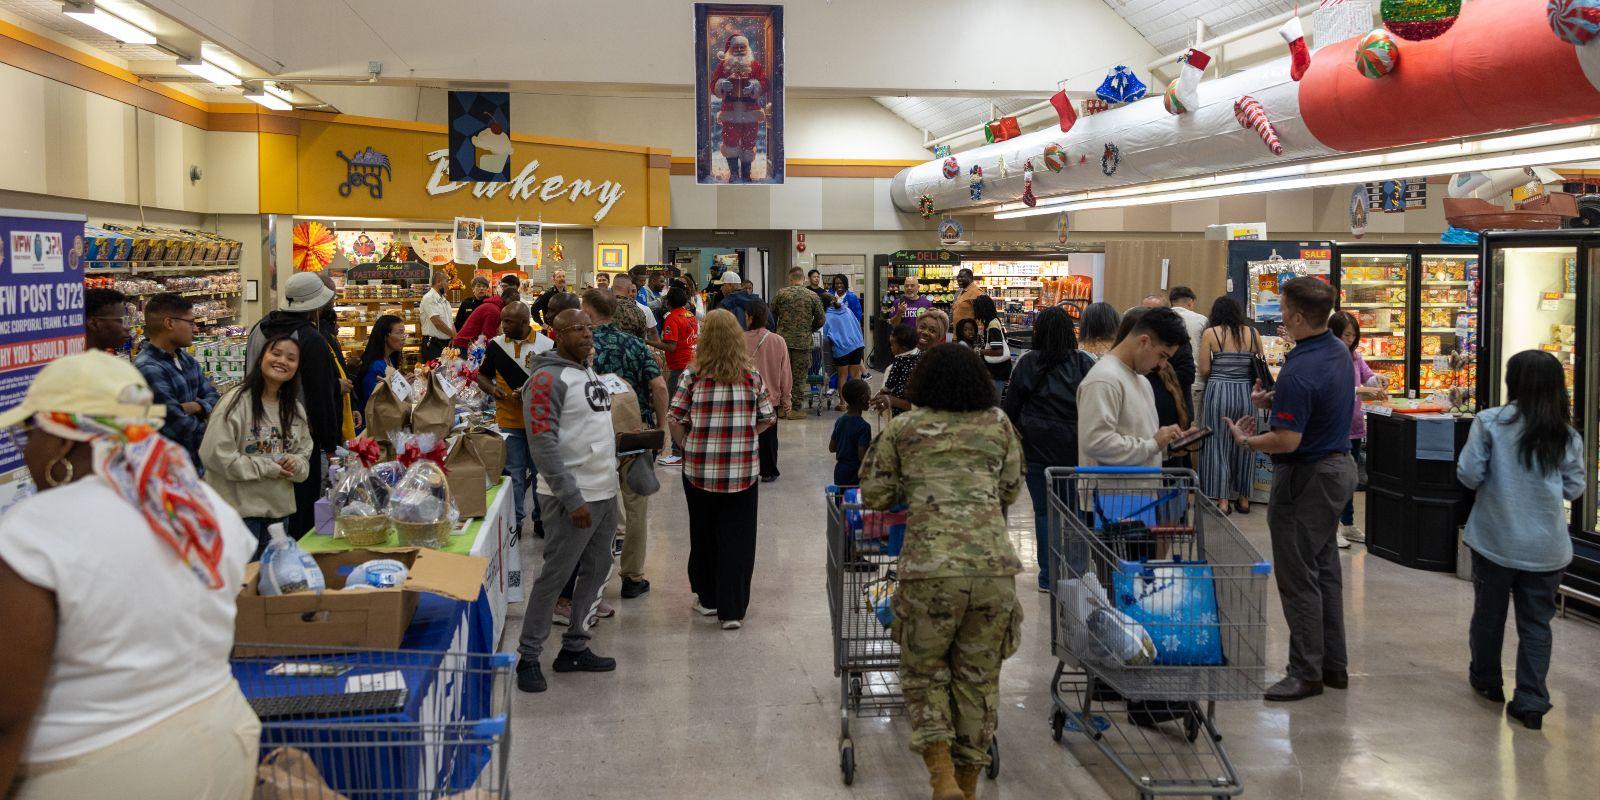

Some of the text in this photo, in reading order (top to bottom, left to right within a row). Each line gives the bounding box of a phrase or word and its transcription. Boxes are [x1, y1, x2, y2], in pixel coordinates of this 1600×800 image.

[917, 251, 938, 261] DELI
[1305, 250, 1327, 258] SALE
[20, 284, 53, 313] POST
[56, 282, 85, 311] 9723
[902, 310, 917, 318] LICK
[11, 318, 42, 333] CORPORAL
[42, 315, 62, 330] FRANK
[62, 315, 68, 328] C.
[12, 344, 30, 365] YOU
[32, 340, 65, 362] SHOULD
[67, 336, 86, 356] JOIN?
